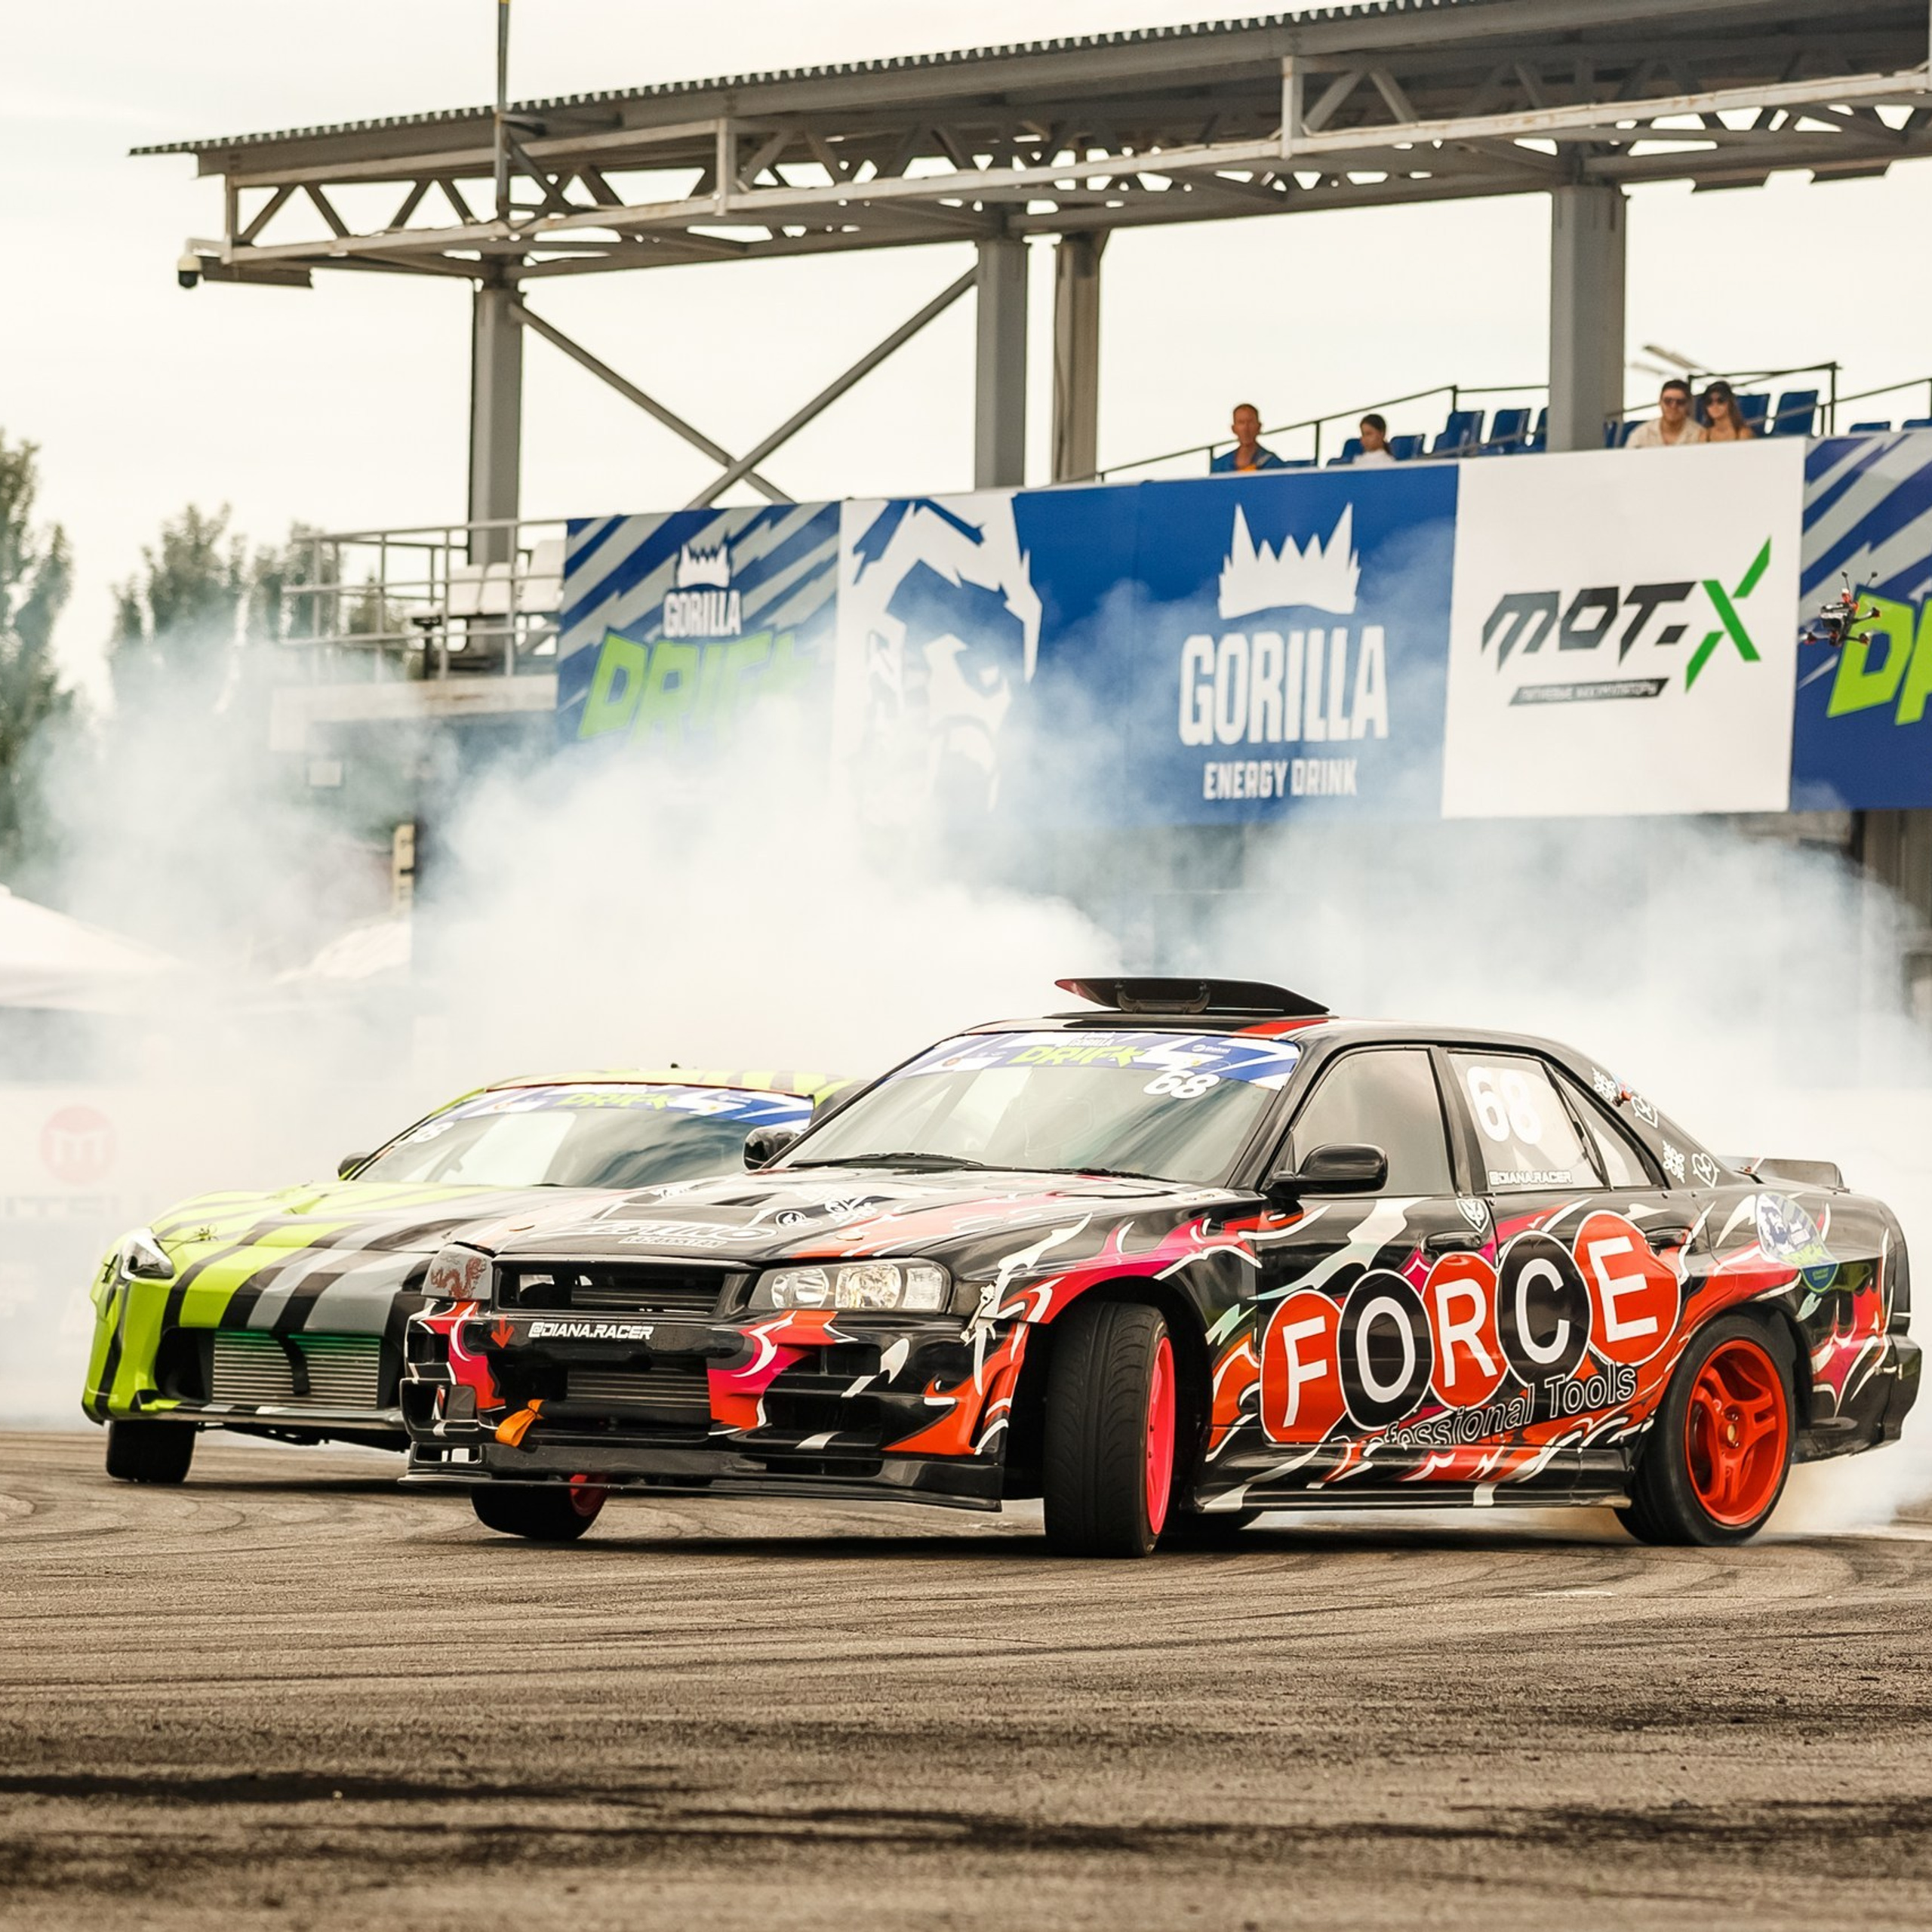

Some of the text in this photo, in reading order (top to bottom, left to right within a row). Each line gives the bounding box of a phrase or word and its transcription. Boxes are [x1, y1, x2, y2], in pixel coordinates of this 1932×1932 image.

[663, 591, 741, 638] GORILLA
[1178, 625, 1389, 746] GORILLA
[1203, 758, 1358, 800] ENERGY DRINK
[1008, 1046, 1146, 1067] DRIFT
[1143, 1070, 1221, 1100] 68
[1466, 1066, 1542, 1145] 68
[528, 1322, 654, 1340] @DIANA.RACER
[1282, 1235, 1659, 1428] FORCE
[1331, 1361, 1637, 1444] fessional Tools
